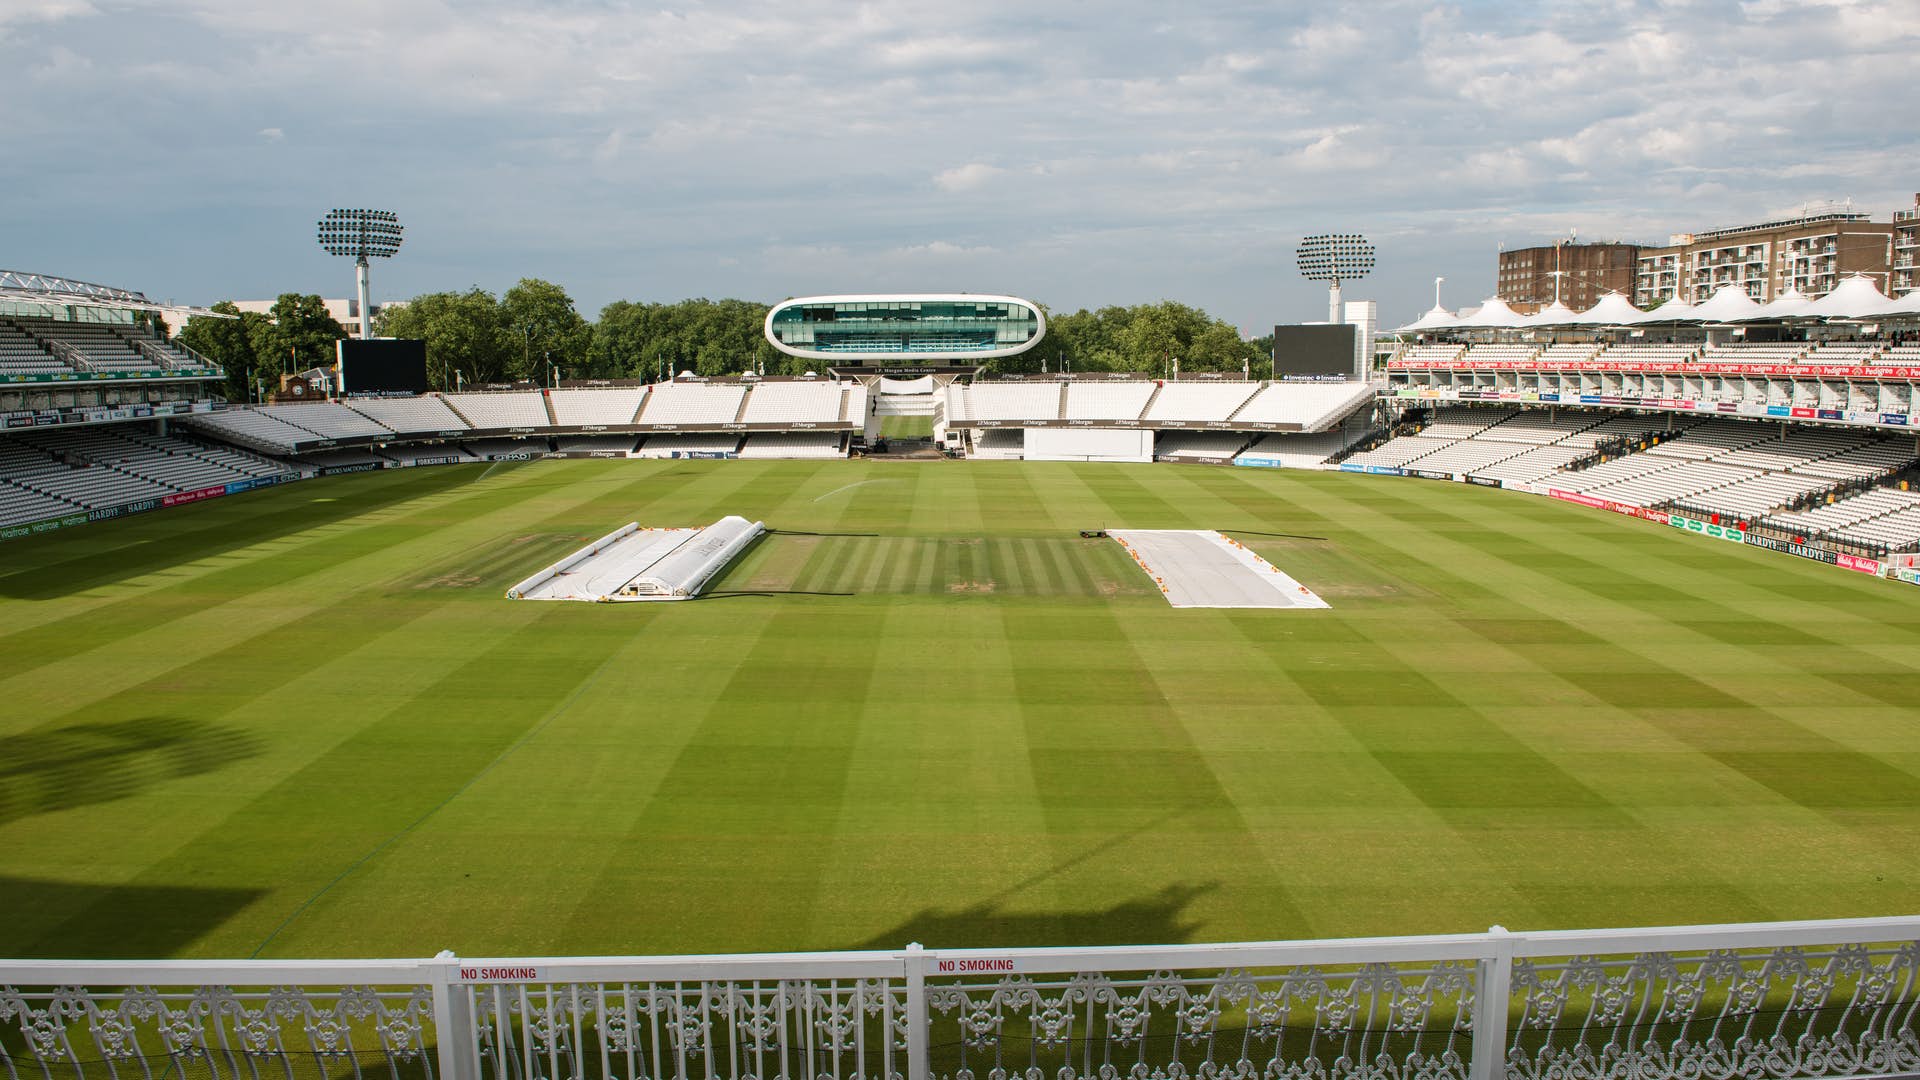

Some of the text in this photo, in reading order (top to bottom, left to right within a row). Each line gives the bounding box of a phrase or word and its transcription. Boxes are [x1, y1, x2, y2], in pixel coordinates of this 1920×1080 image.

[1615, 503, 1636, 515] Pedigree
[1646, 510, 1668, 523] Pedigree
[939, 960, 1013, 971] NO SMOKING
[461, 968, 536, 979] NO SMOKING
